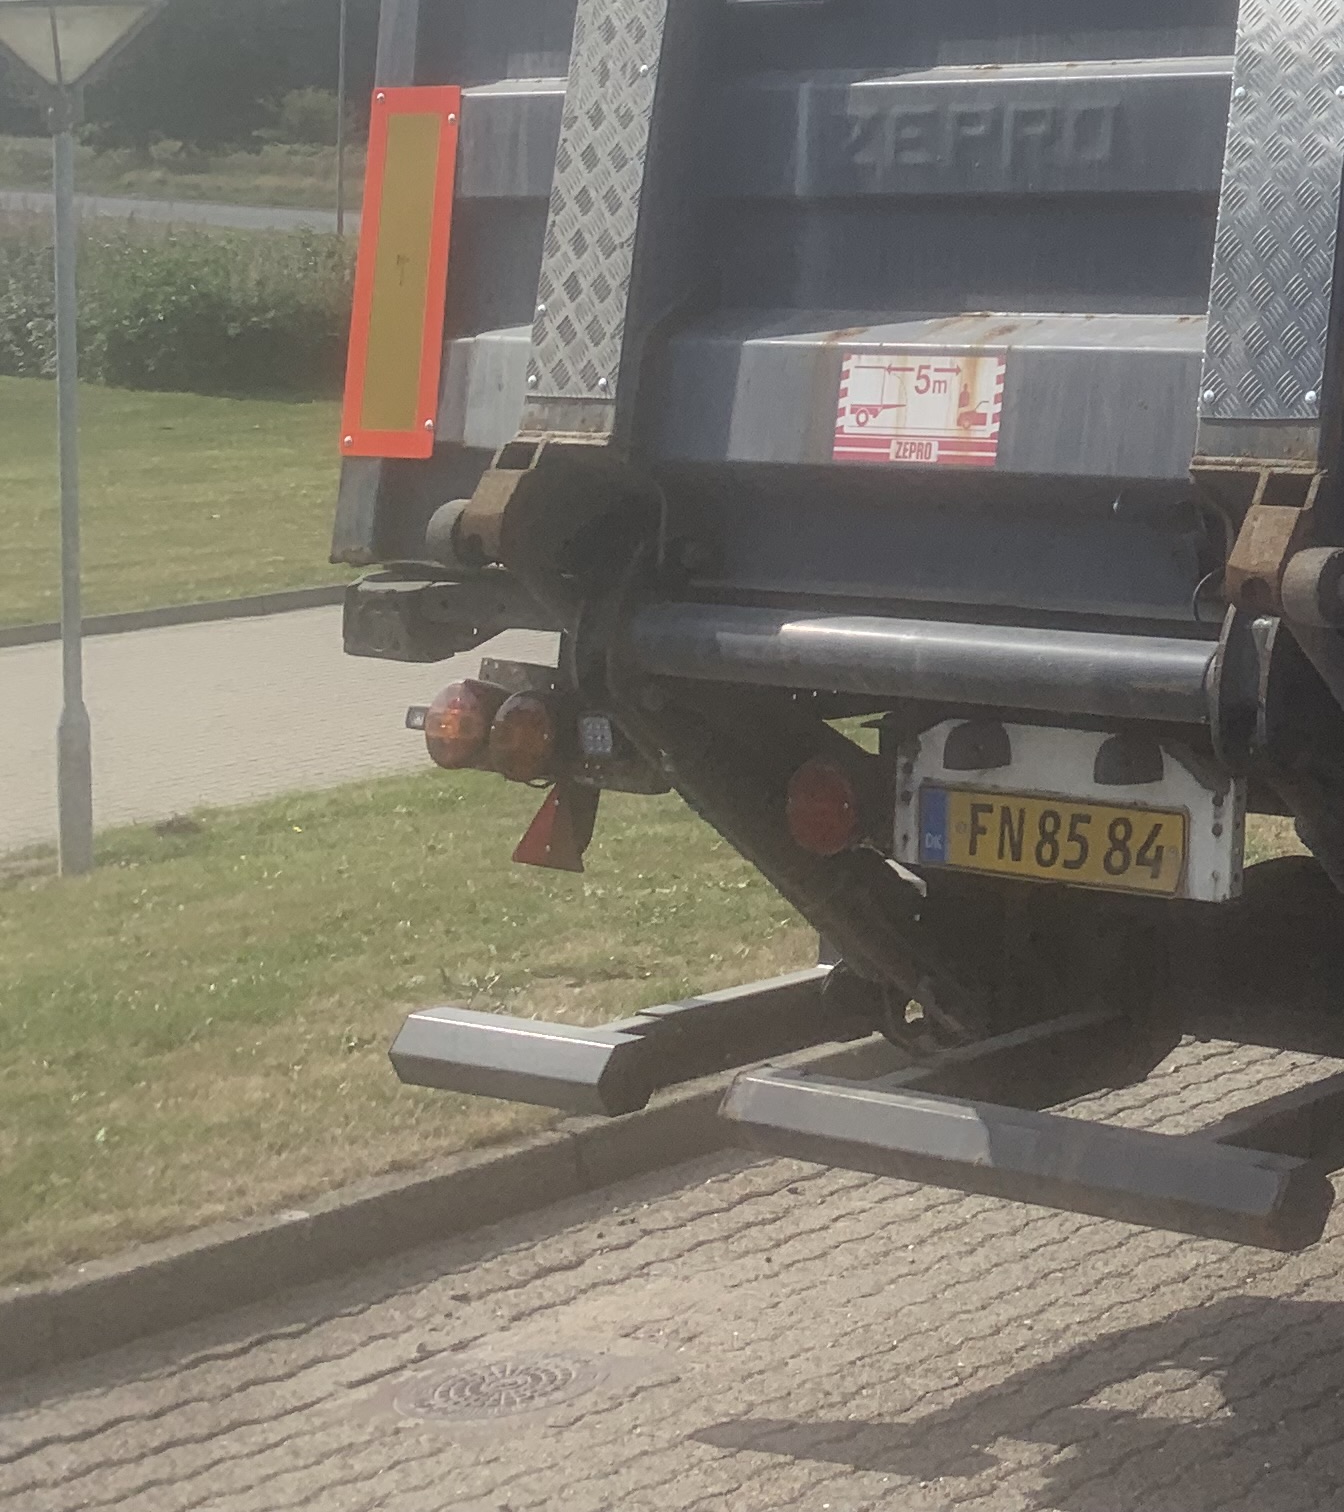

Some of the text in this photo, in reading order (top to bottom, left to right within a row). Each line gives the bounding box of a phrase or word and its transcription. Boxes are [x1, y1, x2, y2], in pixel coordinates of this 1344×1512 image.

[846, 100, 1120, 167] ZEPRO
[895, 441, 933, 460] ZEPRO
[924, 832, 943, 850] DK
